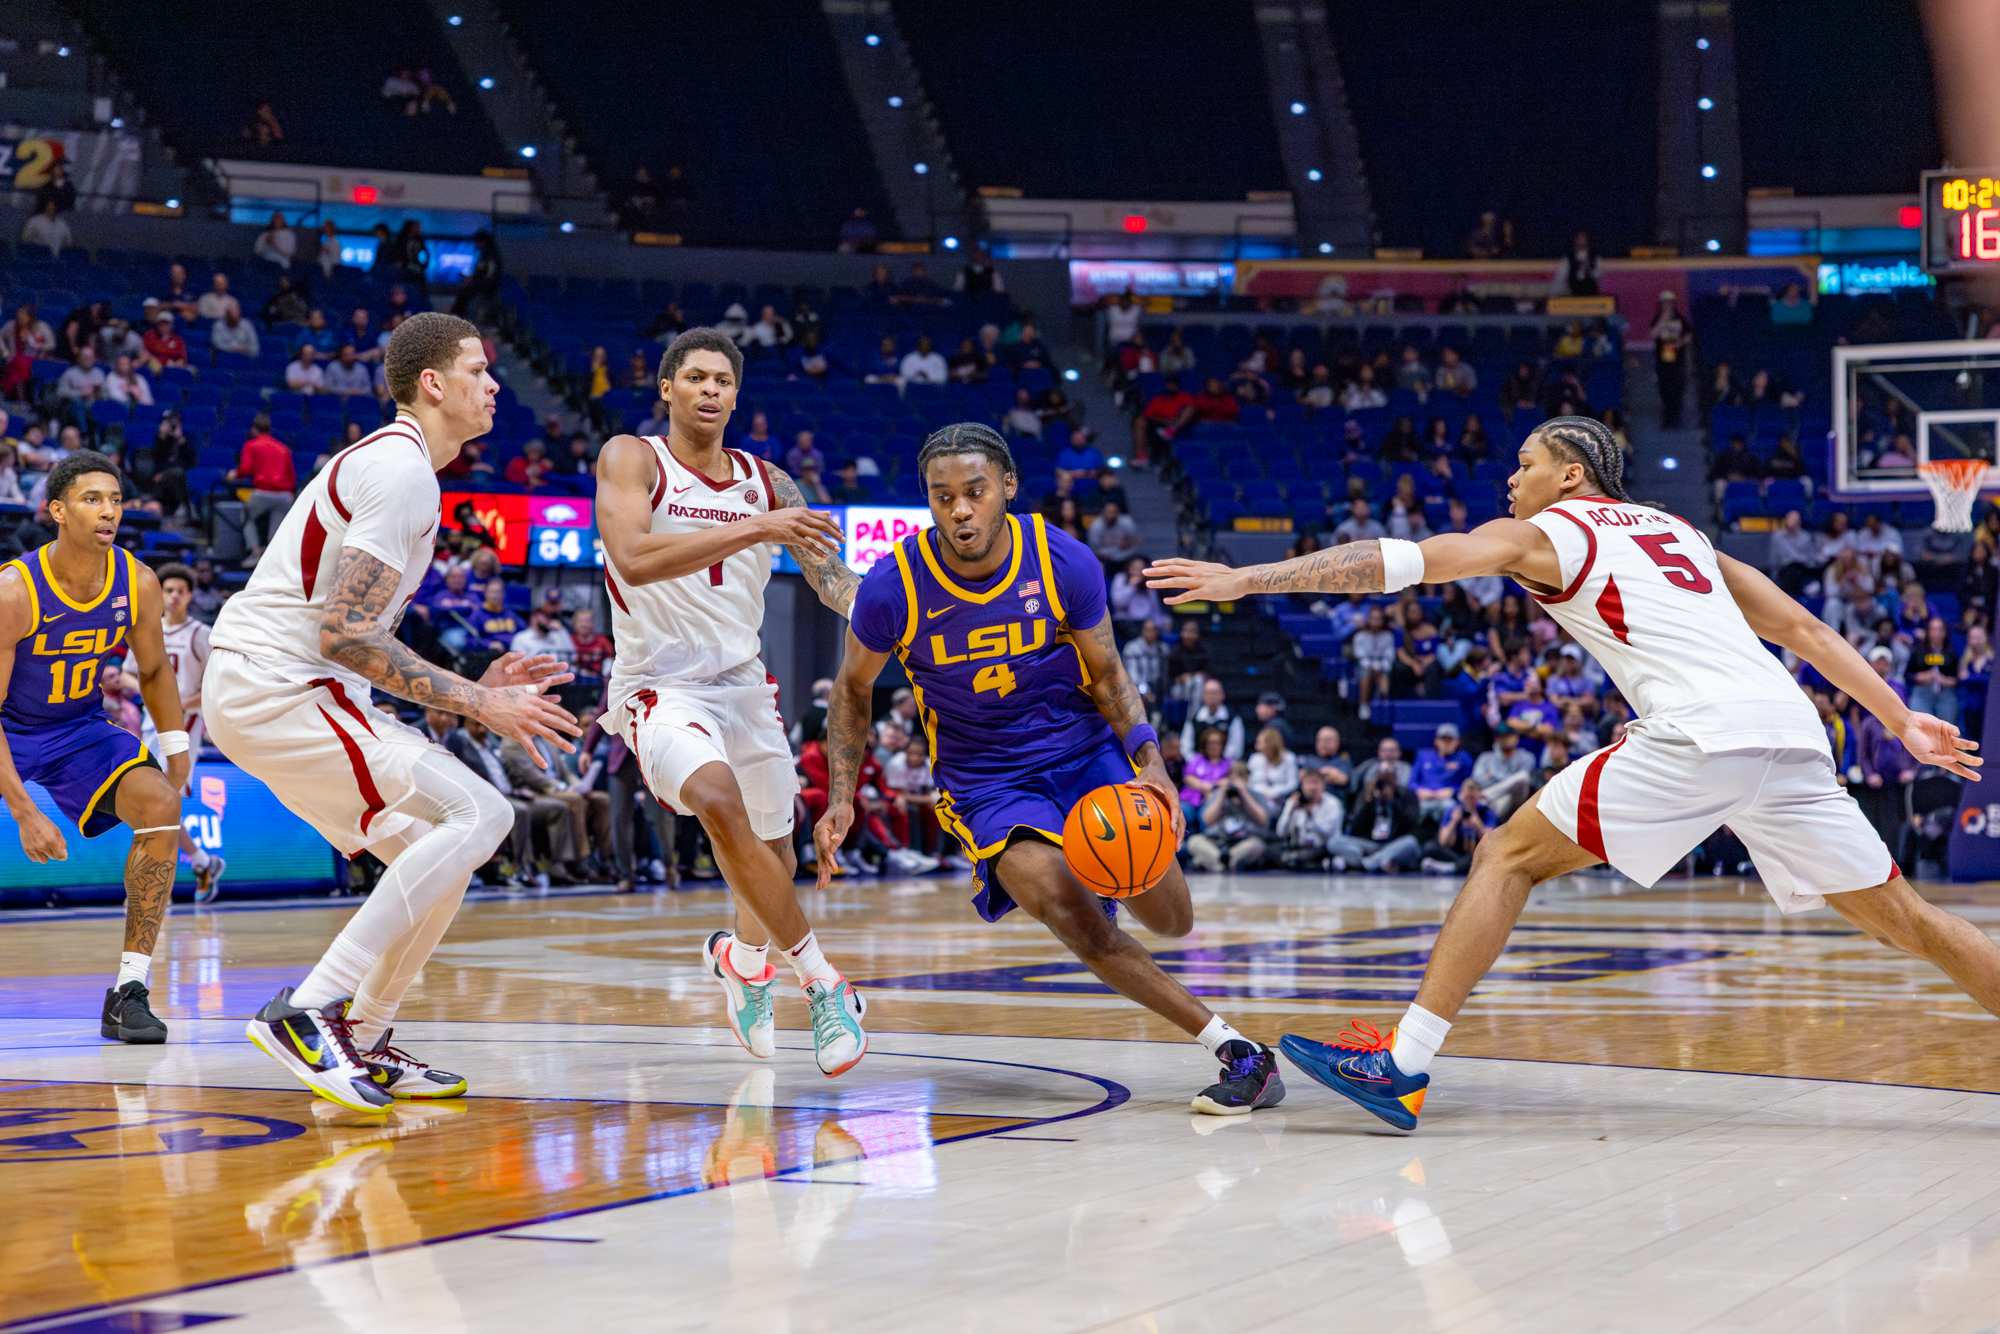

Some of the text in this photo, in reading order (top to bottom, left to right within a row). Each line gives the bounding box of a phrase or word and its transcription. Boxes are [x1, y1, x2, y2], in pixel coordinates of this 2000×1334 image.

[1942, 177, 2000, 211] 10:2
[1960, 208, 2000, 260] 16
[667, 503, 752, 523] RAZORBAC
[538, 529, 581, 562] 64
[1629, 532, 1713, 594] 5
[1300, 555, 1331, 576] No
[32, 625, 126, 656] LSU
[930, 618, 1046, 665] LSU
[48, 658, 99, 704] 10
[972, 663, 1017, 699] 4
[1130, 792, 1152, 831] LSU
